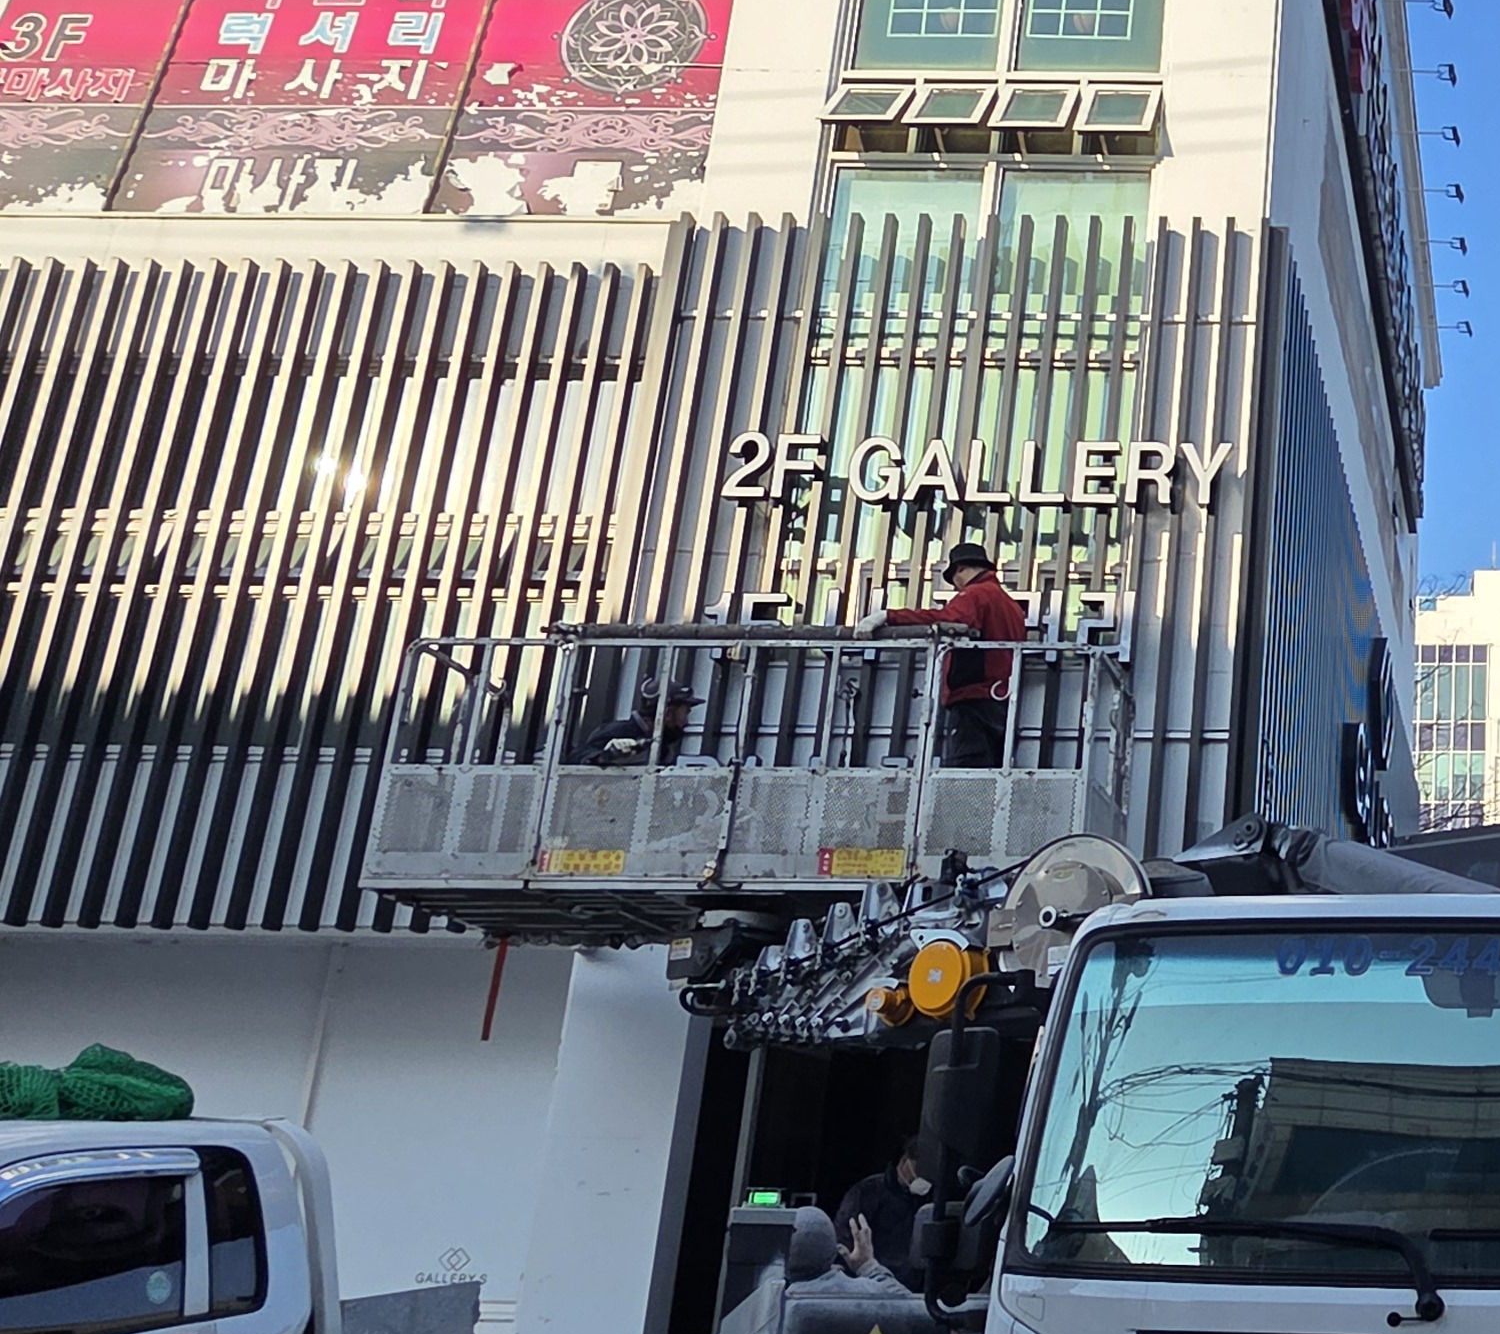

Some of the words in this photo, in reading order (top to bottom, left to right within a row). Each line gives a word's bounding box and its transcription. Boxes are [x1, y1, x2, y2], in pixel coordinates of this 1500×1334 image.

[0, 13, 93, 62] 3F
[720, 431, 826, 500] 2F
[848, 437, 1233, 506] GALLERY
